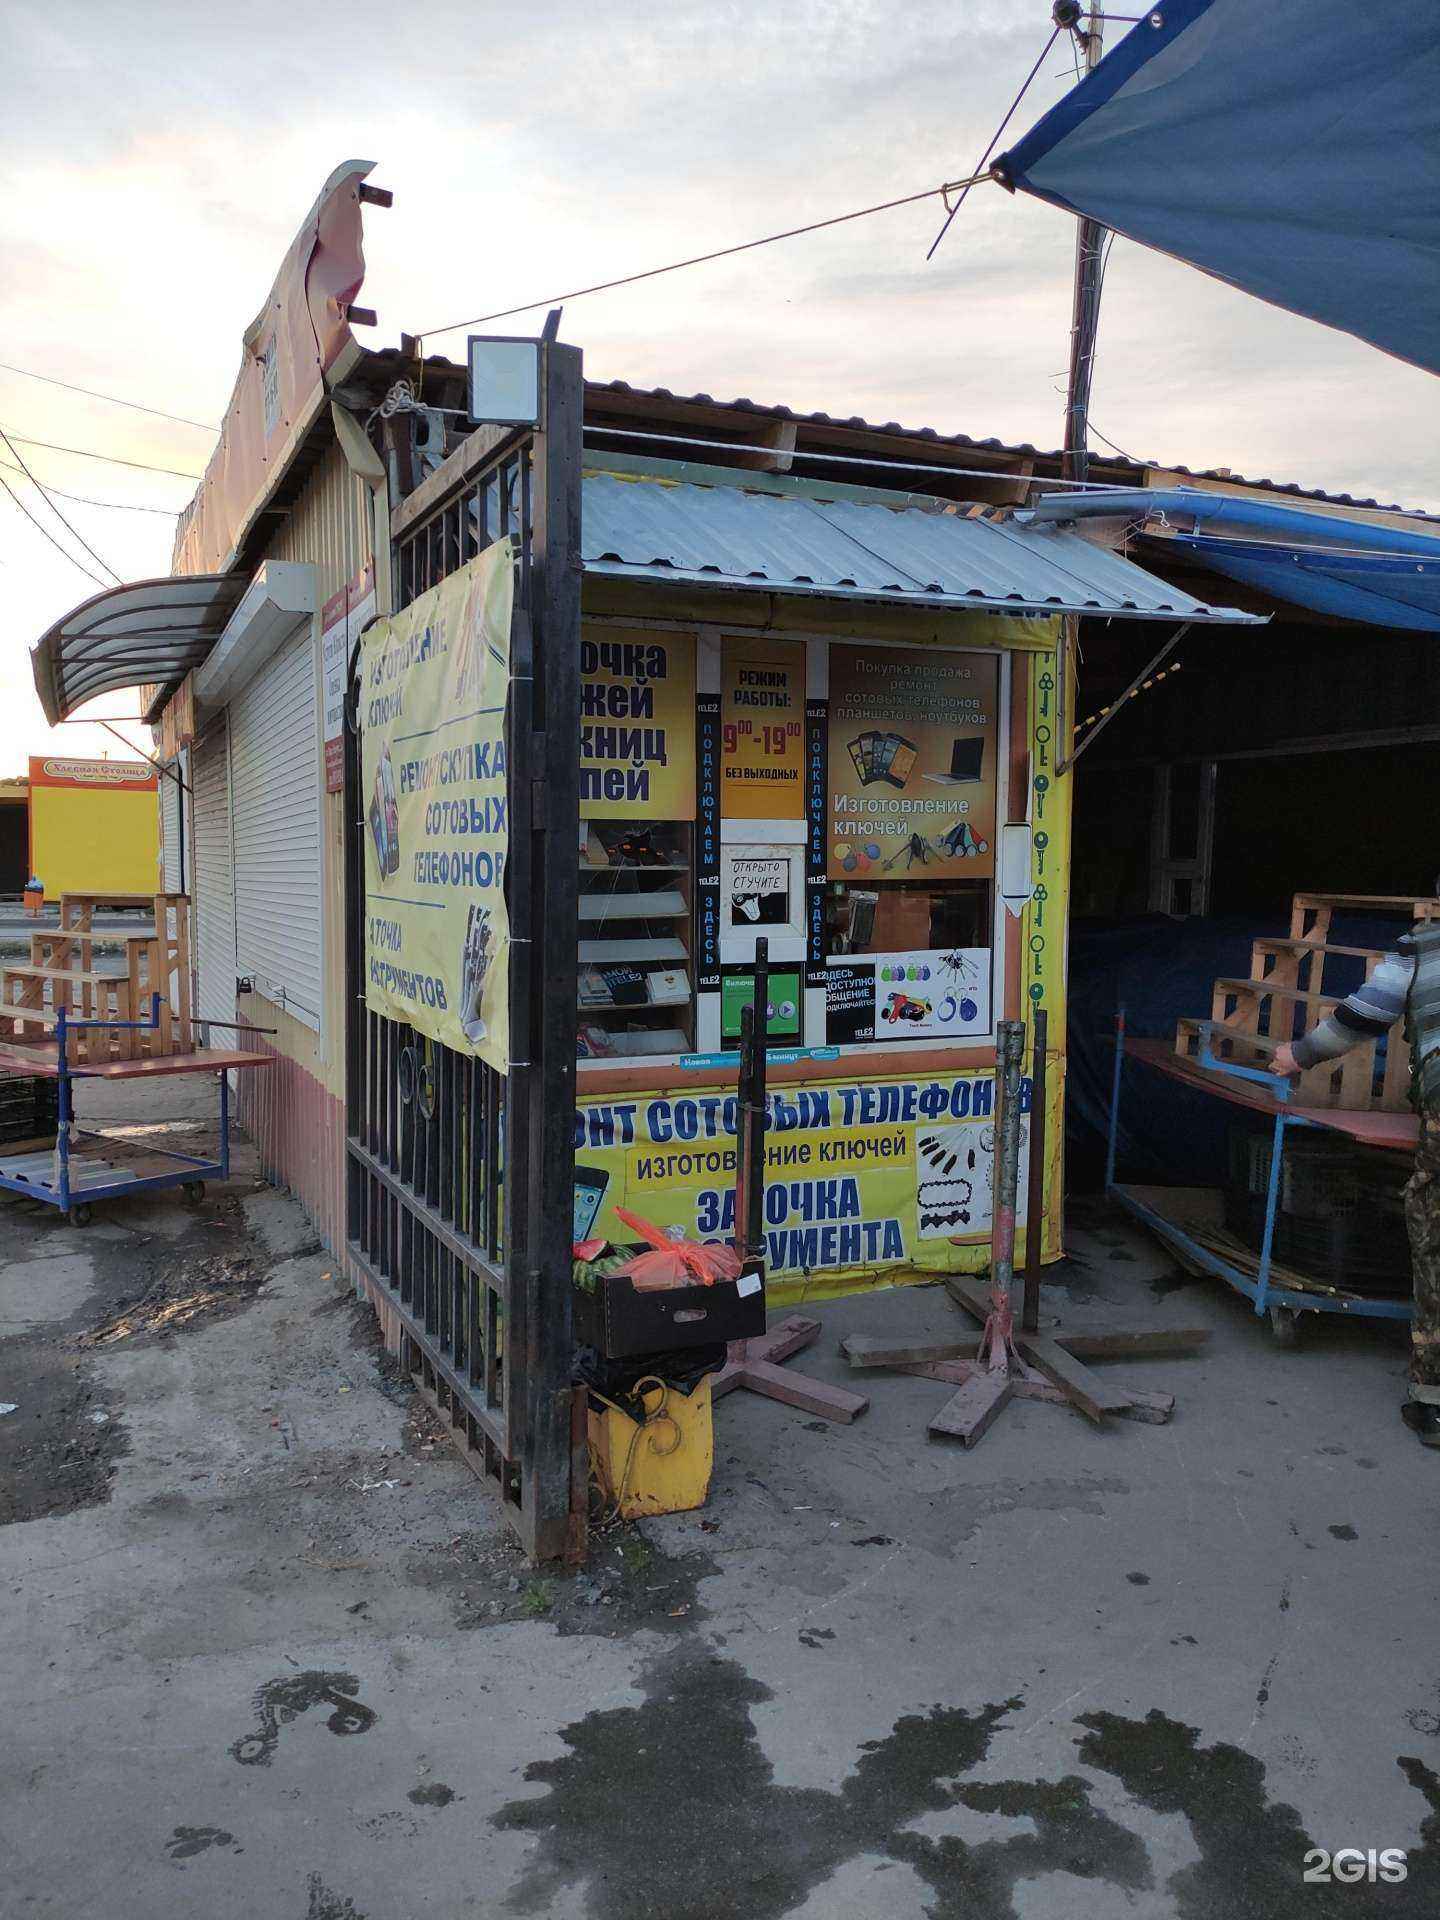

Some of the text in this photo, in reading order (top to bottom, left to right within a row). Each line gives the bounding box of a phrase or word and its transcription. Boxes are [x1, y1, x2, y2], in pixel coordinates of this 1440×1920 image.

[855, 659, 911, 677] Покупка
[739, 669, 787, 687] РЕЖИМ
[734, 690, 792, 708] РАБОТЫ:
[844, 692, 981, 711] сотовых телефонов
[920, 709, 987, 725] ноутбуков
[725, 768, 799, 780] БЕЗ ВЫХОДНЫХ
[833, 795, 970, 815] Изготовление
[425, 796, 507, 836] СОТОВЫХ
[833, 817, 909, 836] ключей
[733, 862, 781, 873] ОТКРЫТО
[699, 875, 720, 886] TELE2
[733, 876, 781, 891] СТУЧИТЕ
[807, 874, 827, 885] TELE2
[699, 974, 720, 985] TELE2
[825, 989, 870, 1003] ОБЩЕНИЕ
[837, 1077, 1033, 1126] ТЕЛЕФОНВ
[819, 1128, 907, 1162] ключей
[697, 1177, 860, 1234] ЗАОЧКА
